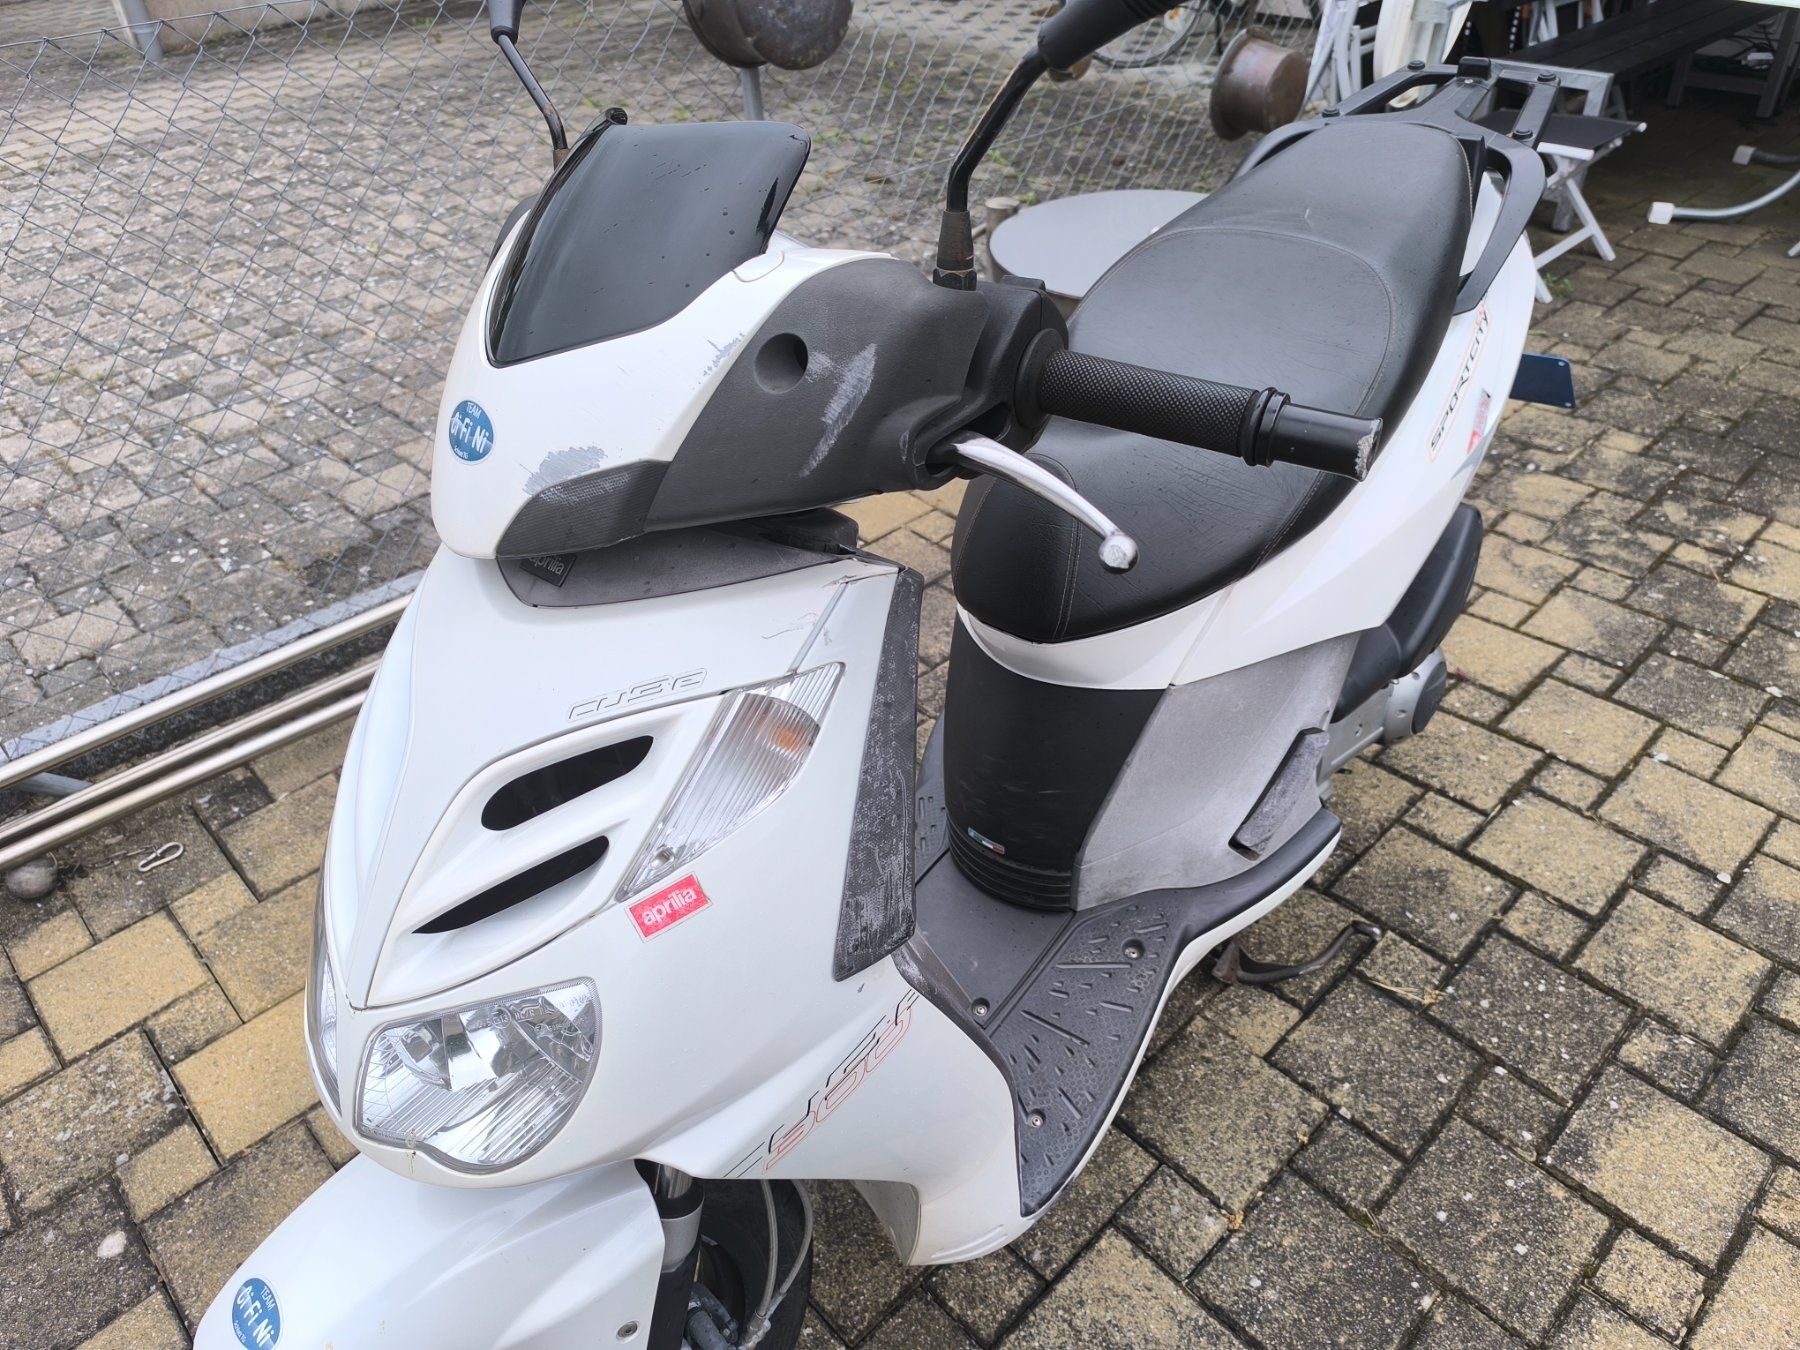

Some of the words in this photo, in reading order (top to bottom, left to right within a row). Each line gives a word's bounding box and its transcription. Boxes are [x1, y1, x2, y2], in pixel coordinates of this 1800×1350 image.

[1431, 309, 1489, 451] SPORTCITY
[466, 401, 482, 419] TEAM
[471, 425, 489, 454] Ni
[568, 670, 705, 720] CUBE
[641, 888, 697, 925] aprilia
[260, 1285, 276, 1311] TEAM
[243, 1300, 263, 1327] Fi
[252, 1318, 275, 1348] Ni
